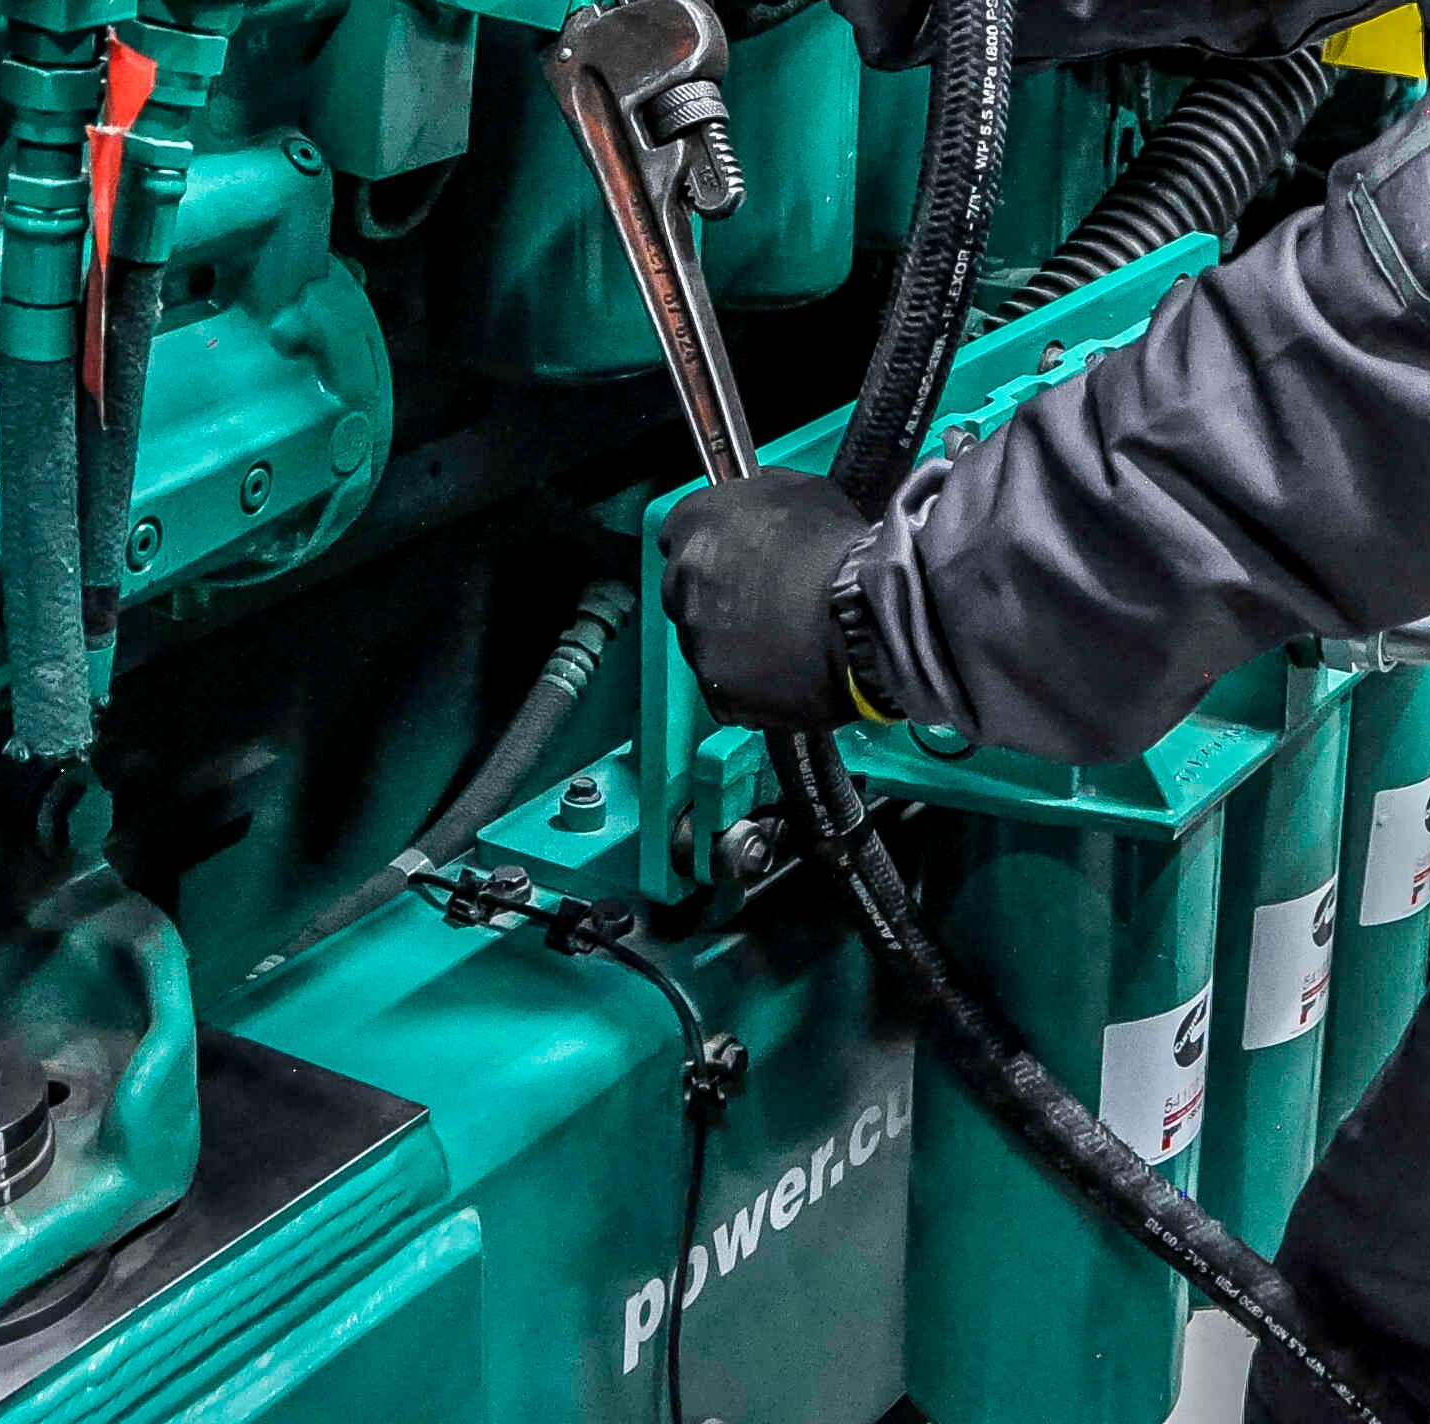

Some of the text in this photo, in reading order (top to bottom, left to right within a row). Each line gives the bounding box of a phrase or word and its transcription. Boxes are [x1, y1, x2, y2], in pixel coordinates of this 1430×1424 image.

[985, 24, 998, 61] (800
[980, 65, 999, 104] MPa
[978, 107, 994, 136] 5.5
[973, 139, 990, 170] WP
[1303, 1353, 1328, 1376] WP
